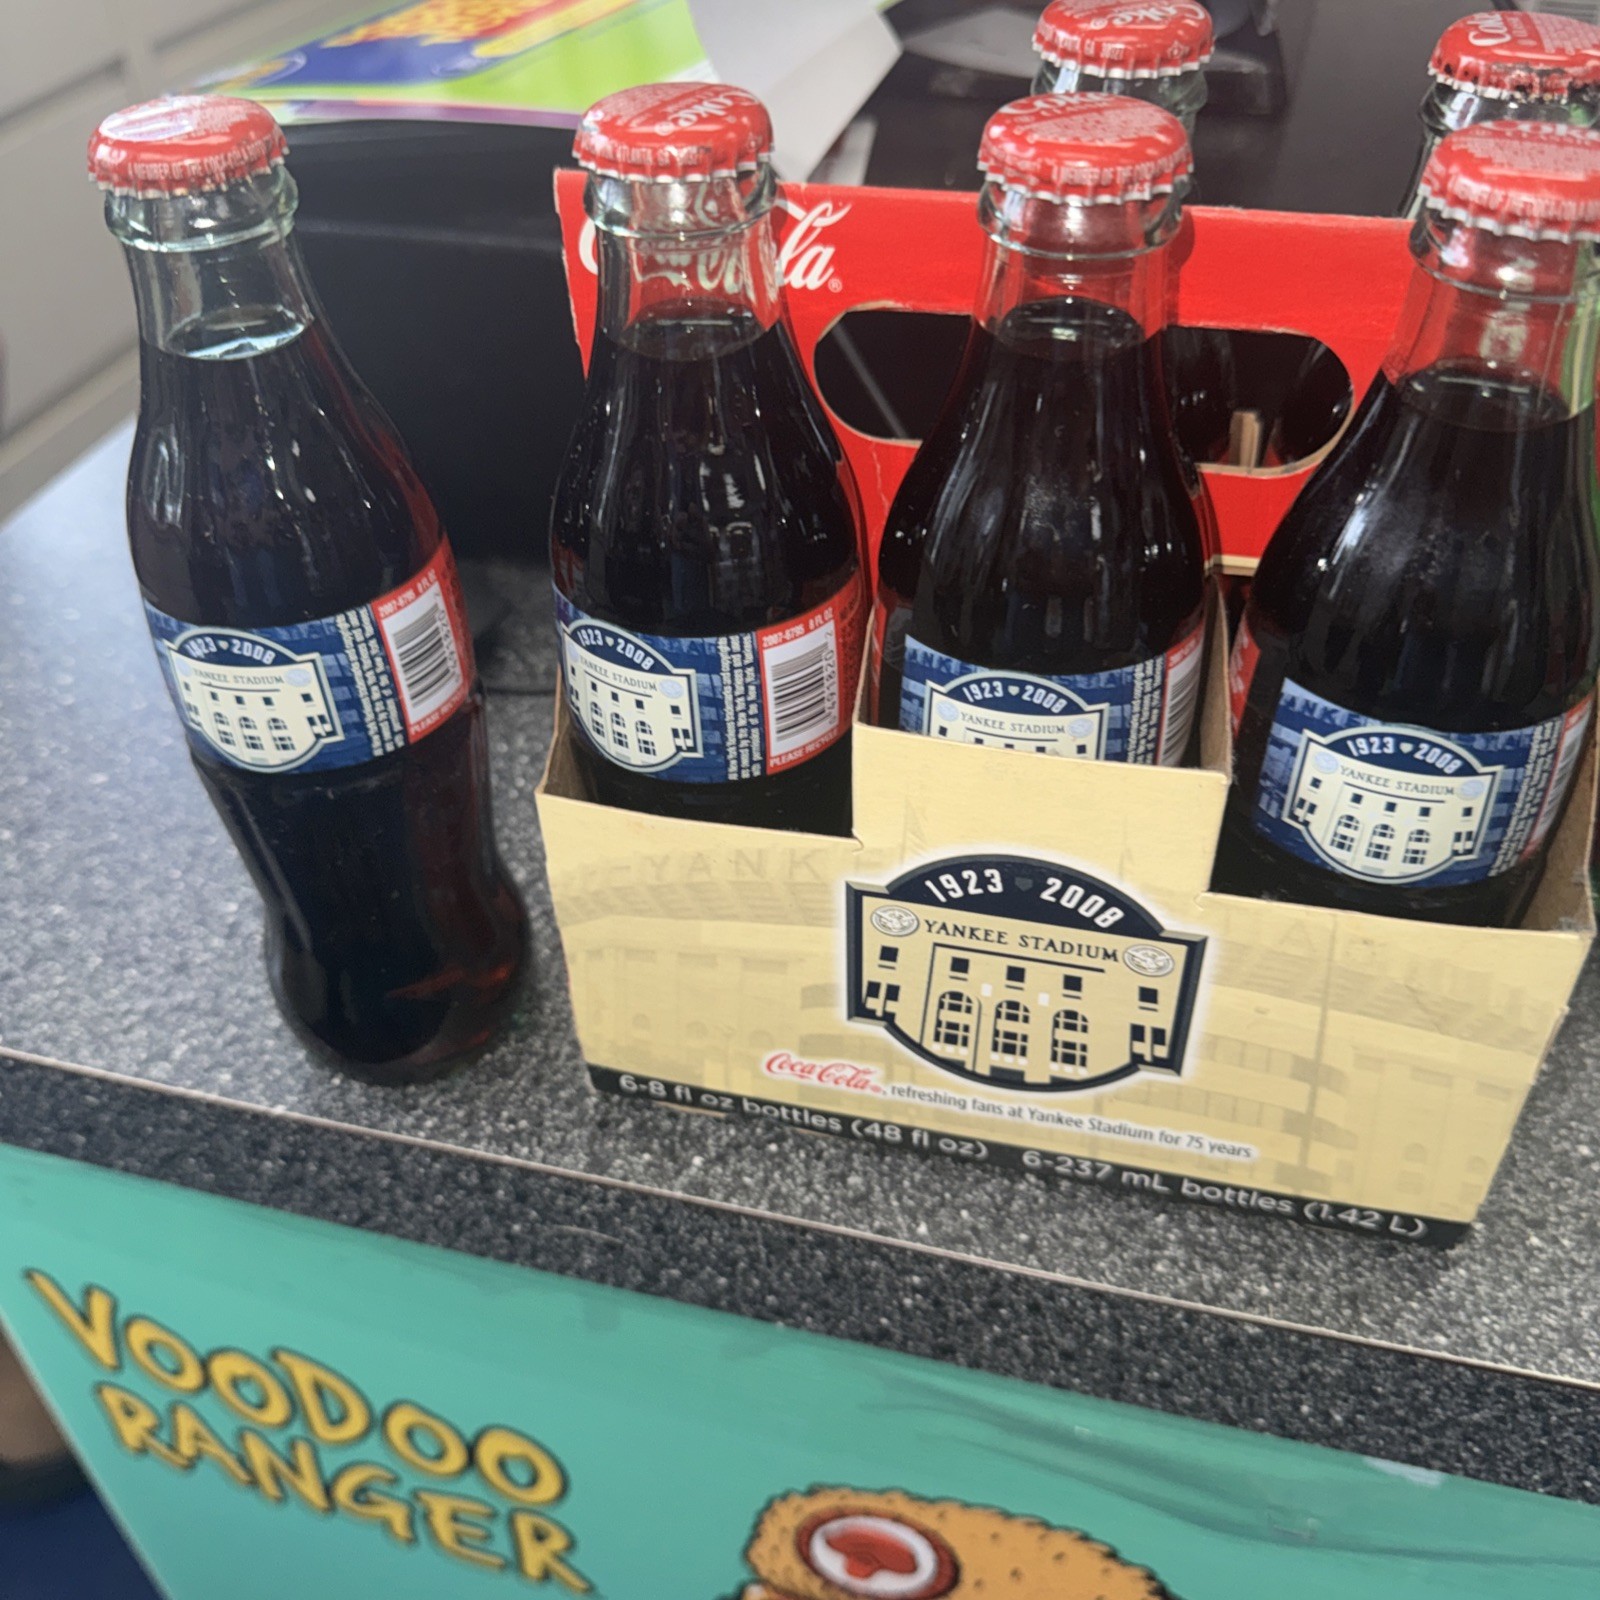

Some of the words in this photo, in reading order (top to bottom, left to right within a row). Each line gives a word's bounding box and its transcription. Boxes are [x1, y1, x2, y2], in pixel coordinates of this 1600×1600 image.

[231, 638, 276, 665] 2008
[576, 628, 603, 647] 1923
[616, 637, 655, 671] 2008
[233, 674, 284, 685] STADIUM
[612, 672, 658, 692] STADIUM
[962, 680, 1004, 703] 1923
[1021, 685, 1068, 714] 2008
[961, 711, 1006, 730] YANKEE
[1010, 721, 1066, 735] STADIUM
[1346, 736, 1395, 757] 1923
[1413, 742, 1463, 774] 2008
[1339, 765, 1390, 788] YANKEE
[1395, 781, 1455, 796] STADIUM
[924, 867, 1003, 903] 1923
[1040, 876, 1125, 929] 2008
[923, 918, 1010, 946] YANKEE
[1018, 934, 1119, 962] STADIUM
[891, 1084, 968, 1111] refreshing
[971, 1097, 1003, 1116] fans
[1007, 1105, 1022, 1119] at
[1027, 1107, 1084, 1129] Yankee
[1088, 1117, 1154, 1141] Stadium
[1158, 1130, 1181, 1146] for
[1186, 1134, 1203, 1149] 75
[1207, 1140, 1252, 1158] years
[618, 1074, 668, 1098] 6-8
[673, 1082, 693, 1105] fl
[700, 1090, 734, 1110] oz
[742, 1098, 842, 1133] bottles
[851, 1118, 902, 1144] (48
[911, 1128, 930, 1148] fl
[938, 1137, 989, 1160] oz)
[1022, 1149, 1113, 1181] 6-237
[1121, 1169, 1171, 1193] mL
[1181, 1173, 1293, 1216] bottles
[1303, 1200, 1381, 1231] (1.42
[1389, 1213, 1429, 1240] L)
[24, 1266, 567, 1504] VOODOO
[94, 1381, 598, 1596] RANGER
